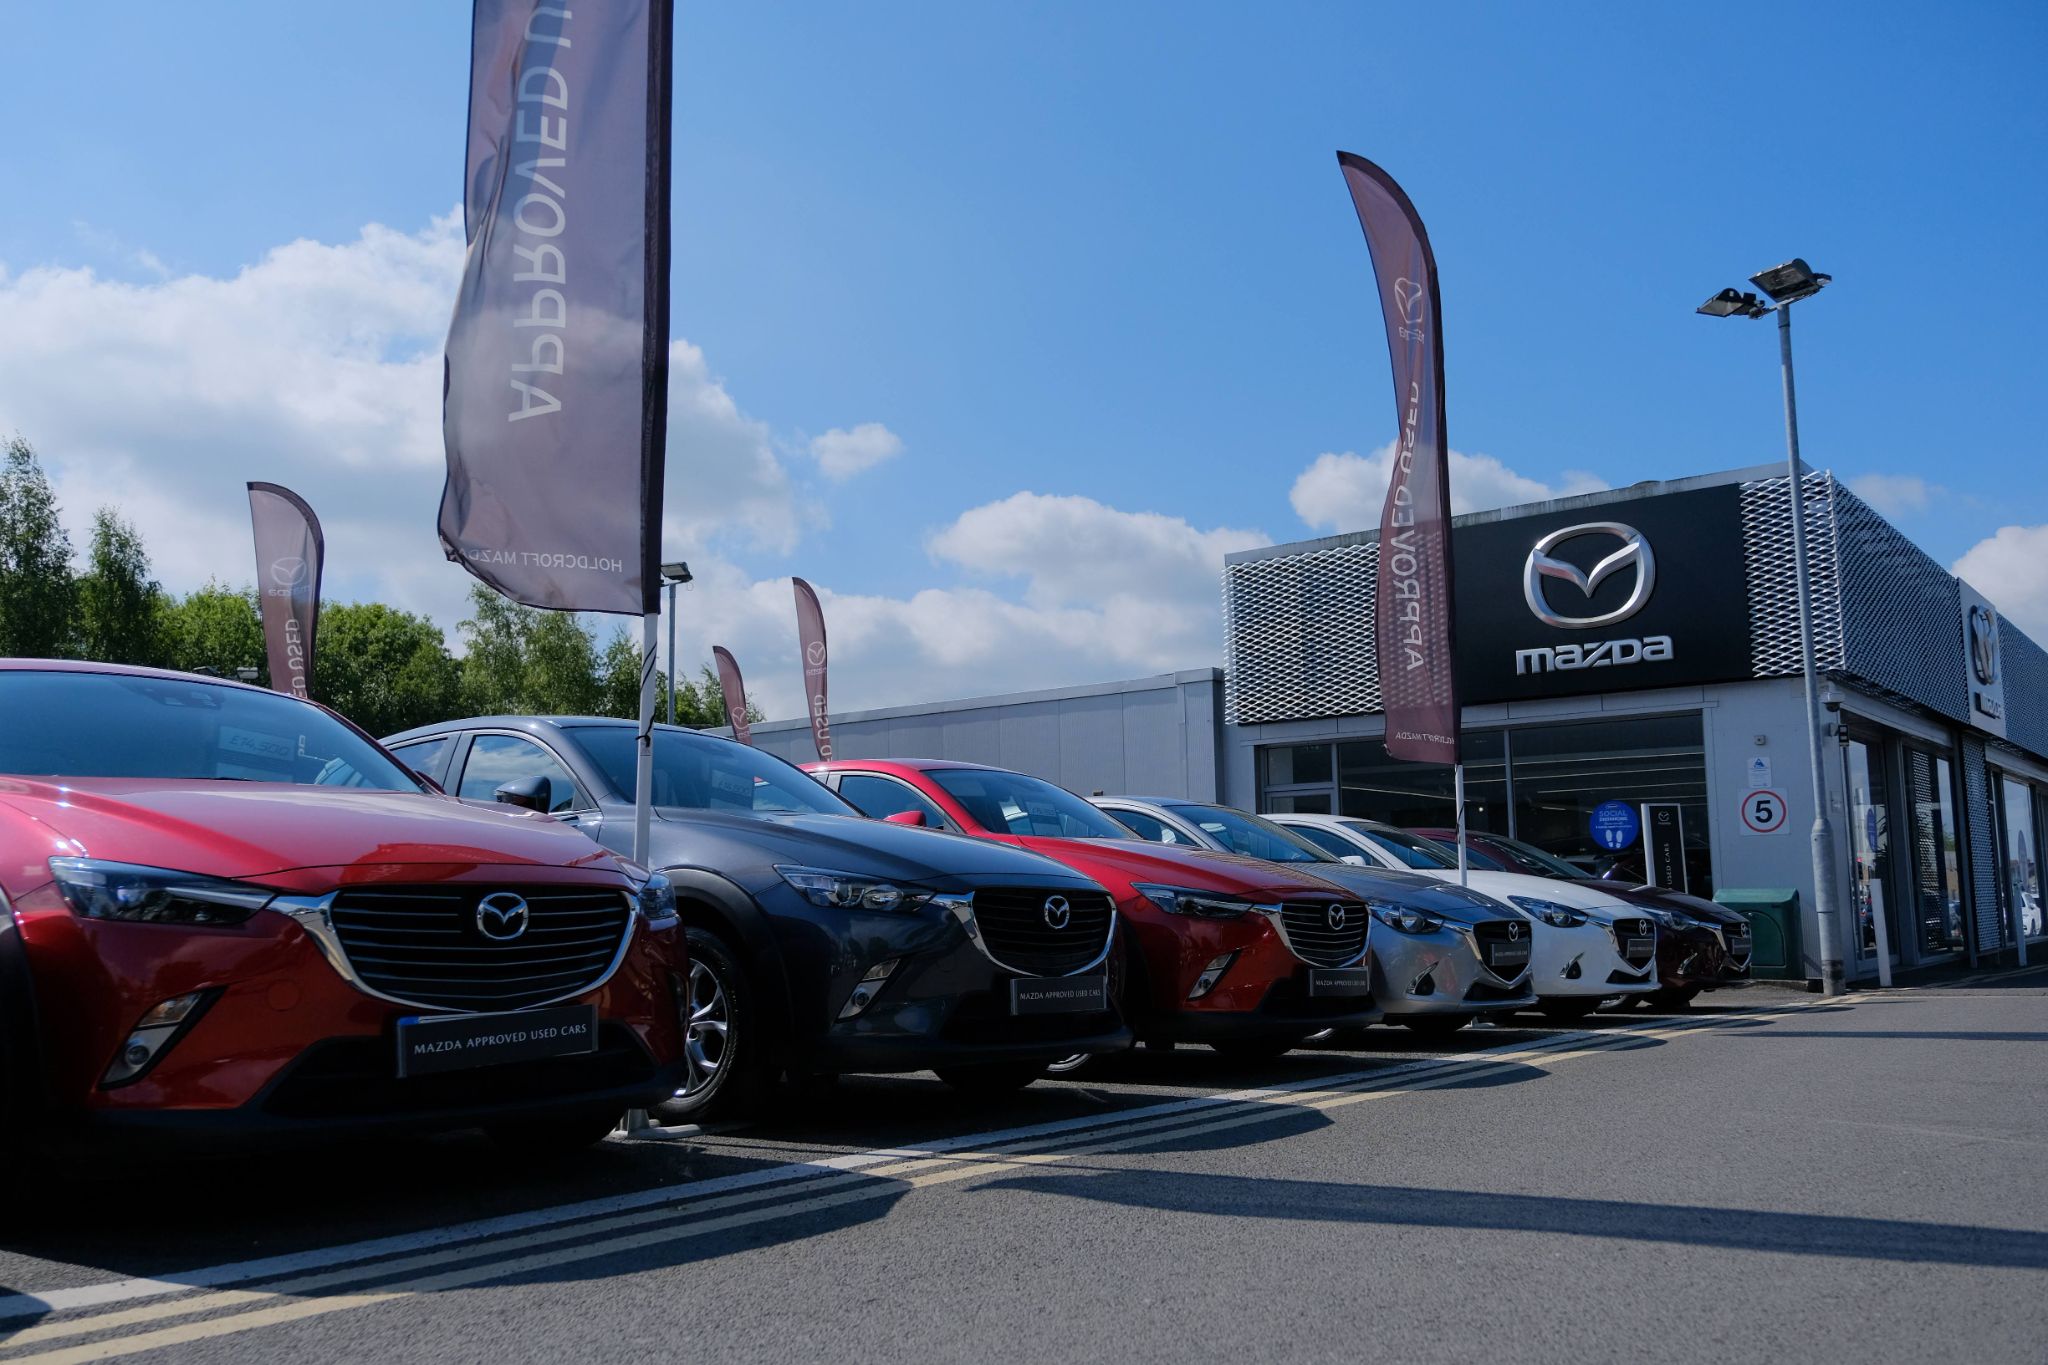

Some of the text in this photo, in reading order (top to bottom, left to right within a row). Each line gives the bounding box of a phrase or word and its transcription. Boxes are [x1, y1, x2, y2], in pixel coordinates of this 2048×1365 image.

[1755, 799, 1773, 824] 5
[1020, 992, 1044, 1000] MAZDA
[1045, 990, 1075, 999] APPROVED
[1075, 989, 1088, 997] USED
[414, 1024, 587, 1055] MAZDA APPROVED USED CARS
